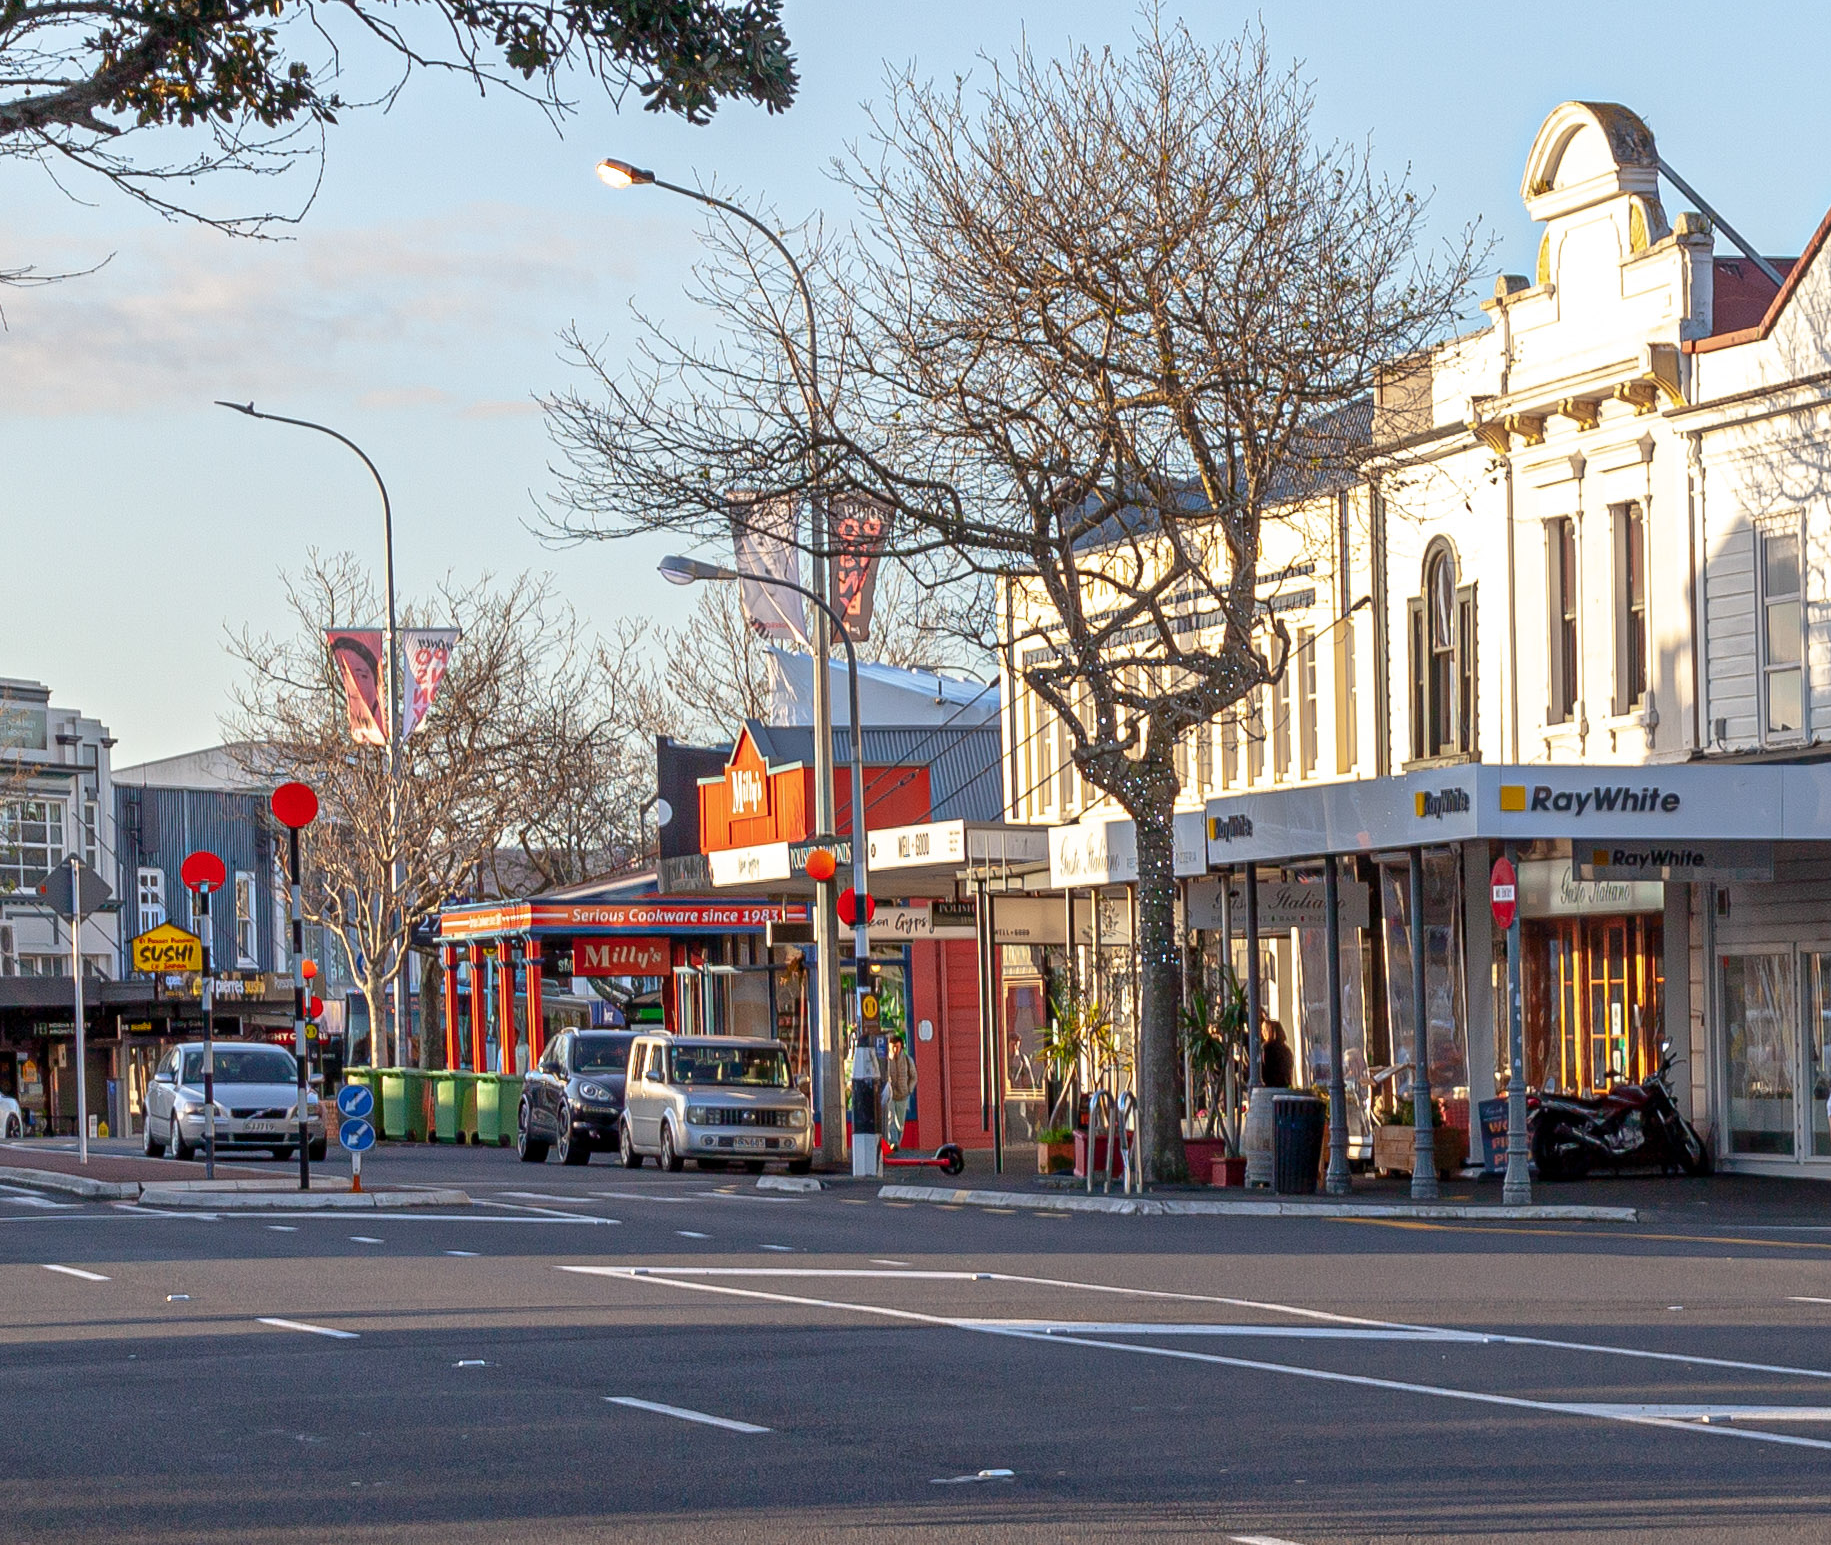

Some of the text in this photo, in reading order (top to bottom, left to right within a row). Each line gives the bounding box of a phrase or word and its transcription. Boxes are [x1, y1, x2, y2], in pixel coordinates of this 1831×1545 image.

[731, 770, 763, 814] Milly's
[1268, 886, 1347, 910] Italiao
[572, 907, 625, 923] Serious
[628, 907, 699, 923] Cookware
[701, 907, 739, 923] since
[139, 944, 194, 963] SUSHI
[583, 943, 662, 970] Milly's
